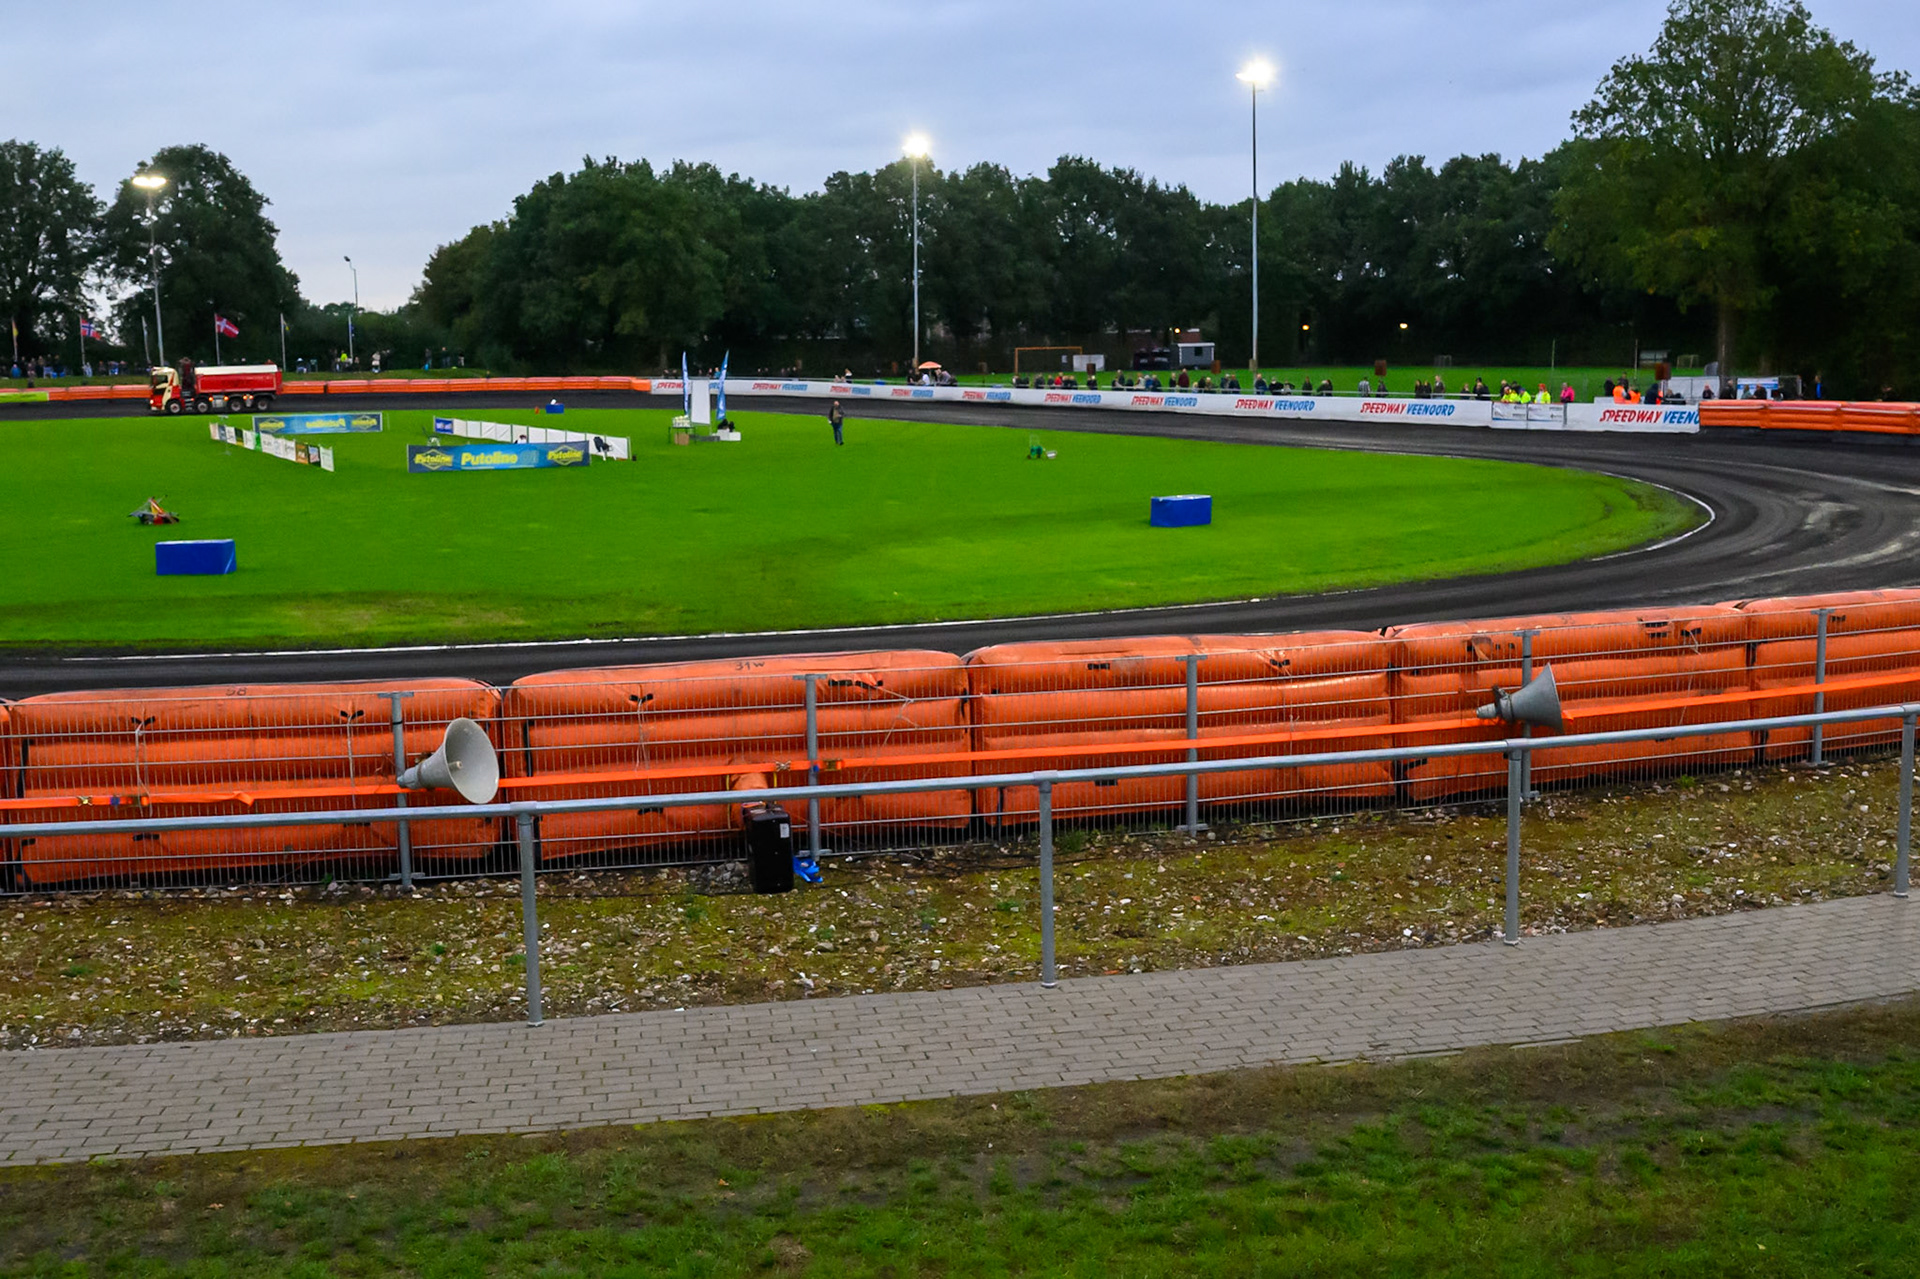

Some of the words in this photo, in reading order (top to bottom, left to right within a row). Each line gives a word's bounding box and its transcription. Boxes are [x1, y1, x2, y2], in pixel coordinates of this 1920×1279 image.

[1131, 395, 1164, 406] SPEEDWAY
[1164, 396, 1198, 407] VEENOORD
[1235, 398, 1274, 410] SPEEDWAY
[1274, 399, 1316, 411] VEENOORD
[1360, 402, 1407, 414] SPEEDWAY
[1406, 403, 1456, 416] VEENOORD
[1599, 409, 1663, 425] SPEEDWAY
[461, 451, 518, 466] Putoline
